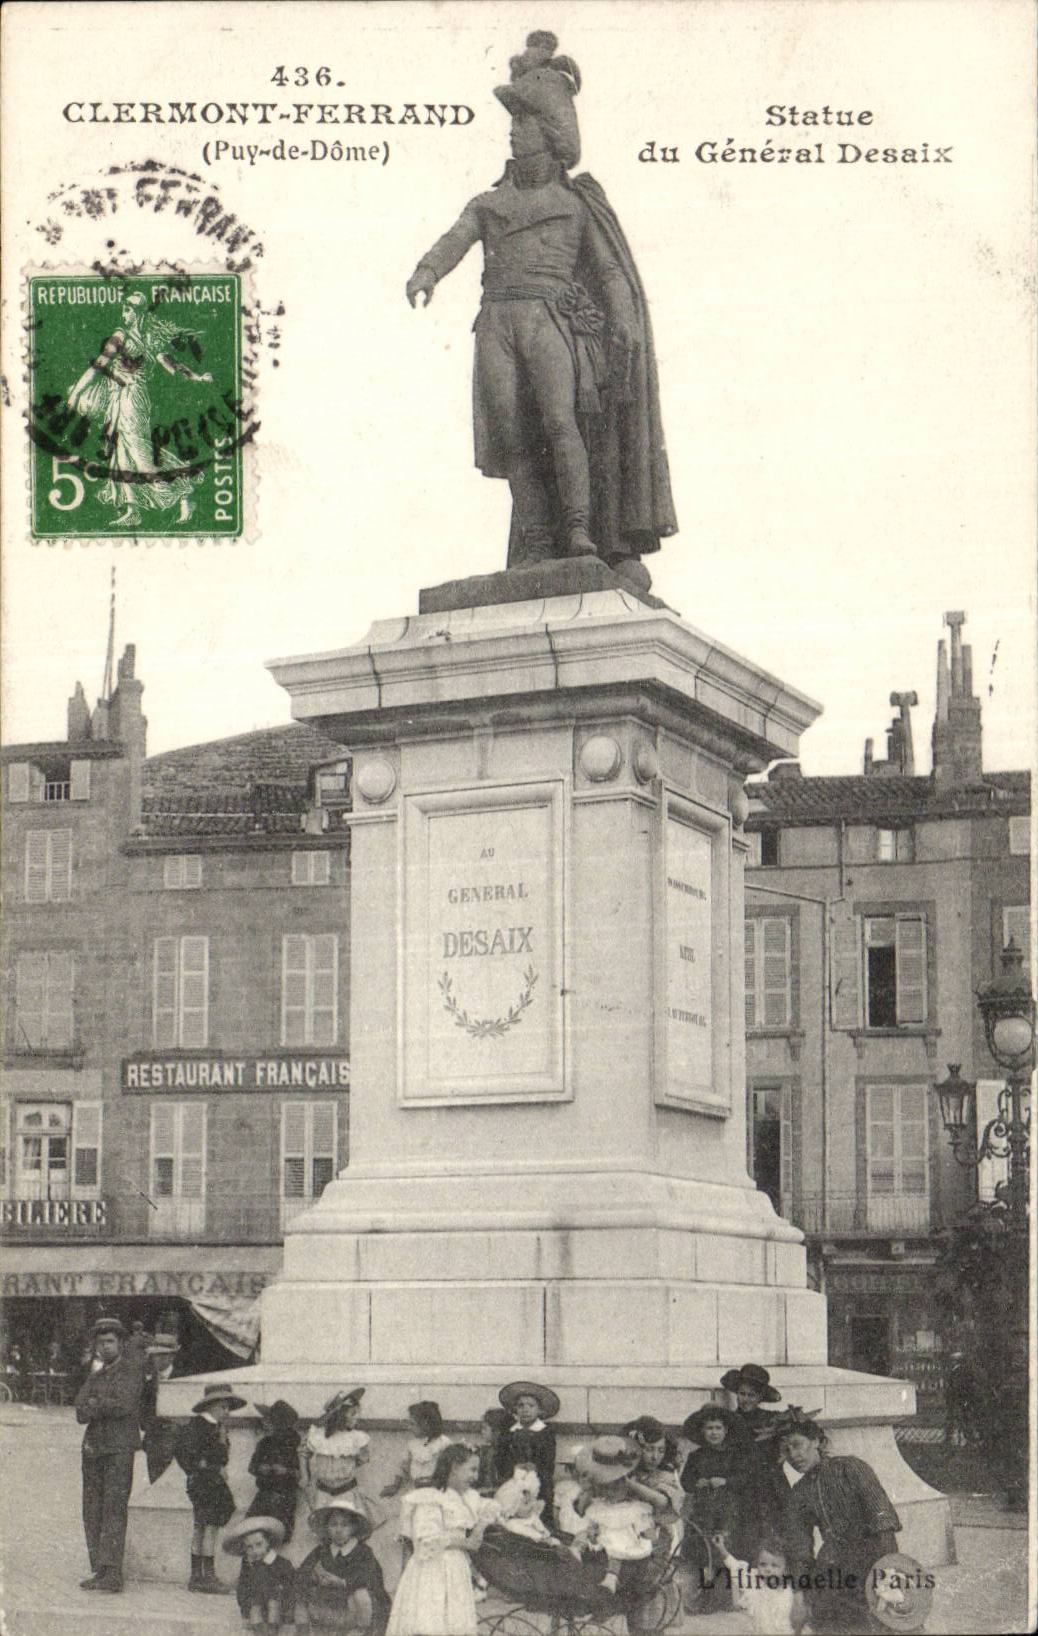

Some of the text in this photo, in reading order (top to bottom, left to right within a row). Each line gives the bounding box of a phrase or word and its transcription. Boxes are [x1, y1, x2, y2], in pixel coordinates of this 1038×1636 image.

[152, 285, 232, 305] FRANÇAISE
[214, 436, 234, 521] POSTES
[442, 926, 534, 959] DESAIX
[127, 1061, 350, 1089] RESTAURANT FRANÇAIS
